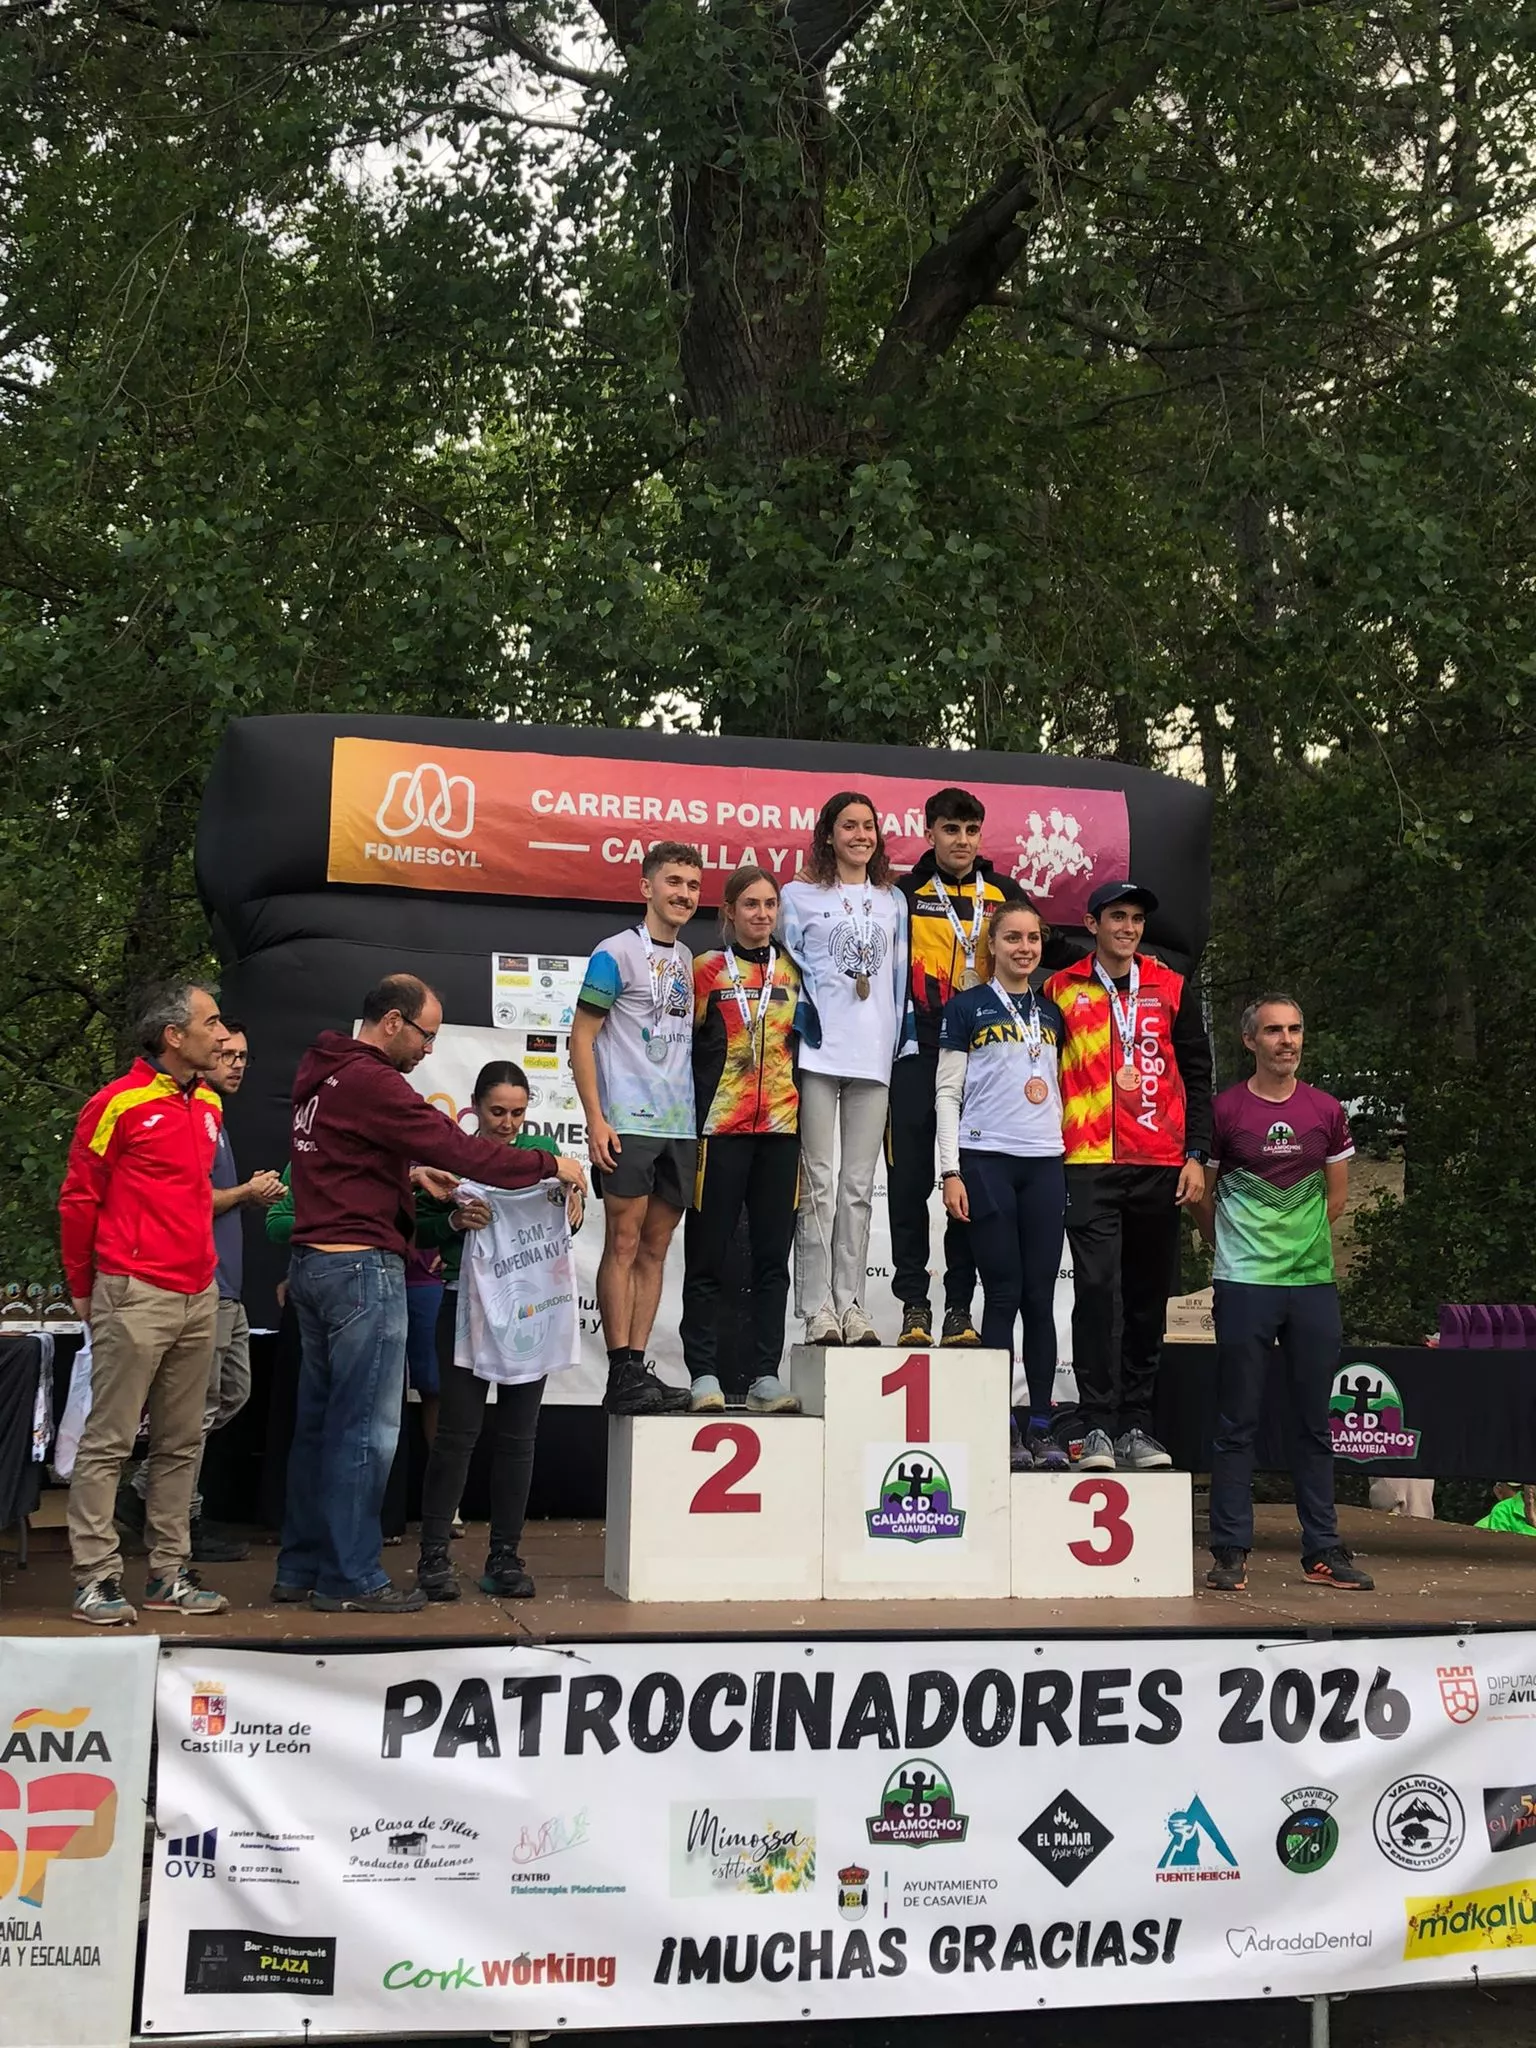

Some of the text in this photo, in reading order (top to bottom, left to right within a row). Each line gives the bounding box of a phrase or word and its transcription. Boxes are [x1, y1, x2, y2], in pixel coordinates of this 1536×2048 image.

[531, 788, 709, 825] CARRERAS
[716, 803, 783, 830] POR
[364, 842, 482, 868] FDMESCYL
[768, 848, 788, 873] Y
[1134, 1017, 1165, 1132] Aragón
[544, 1240, 560, 1260] KV
[866, 1267, 889, 1277] CYL
[882, 1354, 930, 1443] 1
[1332, 1443, 1387, 1454] CASAVIEJA
[689, 1422, 762, 1514] 2
[872, 1513, 960, 1527] CALAMOCHOS
[892, 1523, 937, 1534] CASAVIEJA
[1067, 1478, 1134, 1567] 3
[1489, 1693, 1506, 1706] DE
[381, 1665, 1412, 1758] PATROCINADORES 2026
[230, 1721, 311, 1736] Junta de
[180, 1738, 311, 1758] Castilla y León
[1285, 1790, 1333, 1804] CASAVIEJA
[1388, 1779, 1449, 1800] VALMON
[1302, 1800, 1318, 1808] C.F.
[350, 1816, 480, 1842] La Casa de Pilar
[872, 1818, 962, 1833] CALAMOCHOS
[892, 1830, 939, 1839] CASAVIEJA
[687, 1808, 806, 1863] Mimossa
[1037, 1831, 1091, 1847] EL PAJAR
[349, 1855, 474, 1869] Productos Abulenses
[1390, 1846, 1452, 1867] EMBUTIDOS
[165, 1860, 216, 1878] OVB
[511, 1872, 550, 1882] CENTRO
[1156, 1873, 1195, 1883] FUENTE
[511, 1885, 568, 1896] Fisioterapia
[904, 1879, 998, 1892] AYUNTAMIENTO
[904, 1895, 988, 1907] DE CASAVIEJA
[244, 1941, 262, 1951] Bar
[272, 1945, 327, 1957] Restaurante
[1244, 1930, 1373, 1952] AdradaDental
[17, 1946, 26, 1967] Y
[31, 1946, 101, 1966] ESCALADA
[653, 1918, 1183, 1985] ¡MUCHAS GRACIAS!
[260, 1955, 309, 1974] PLAZA
